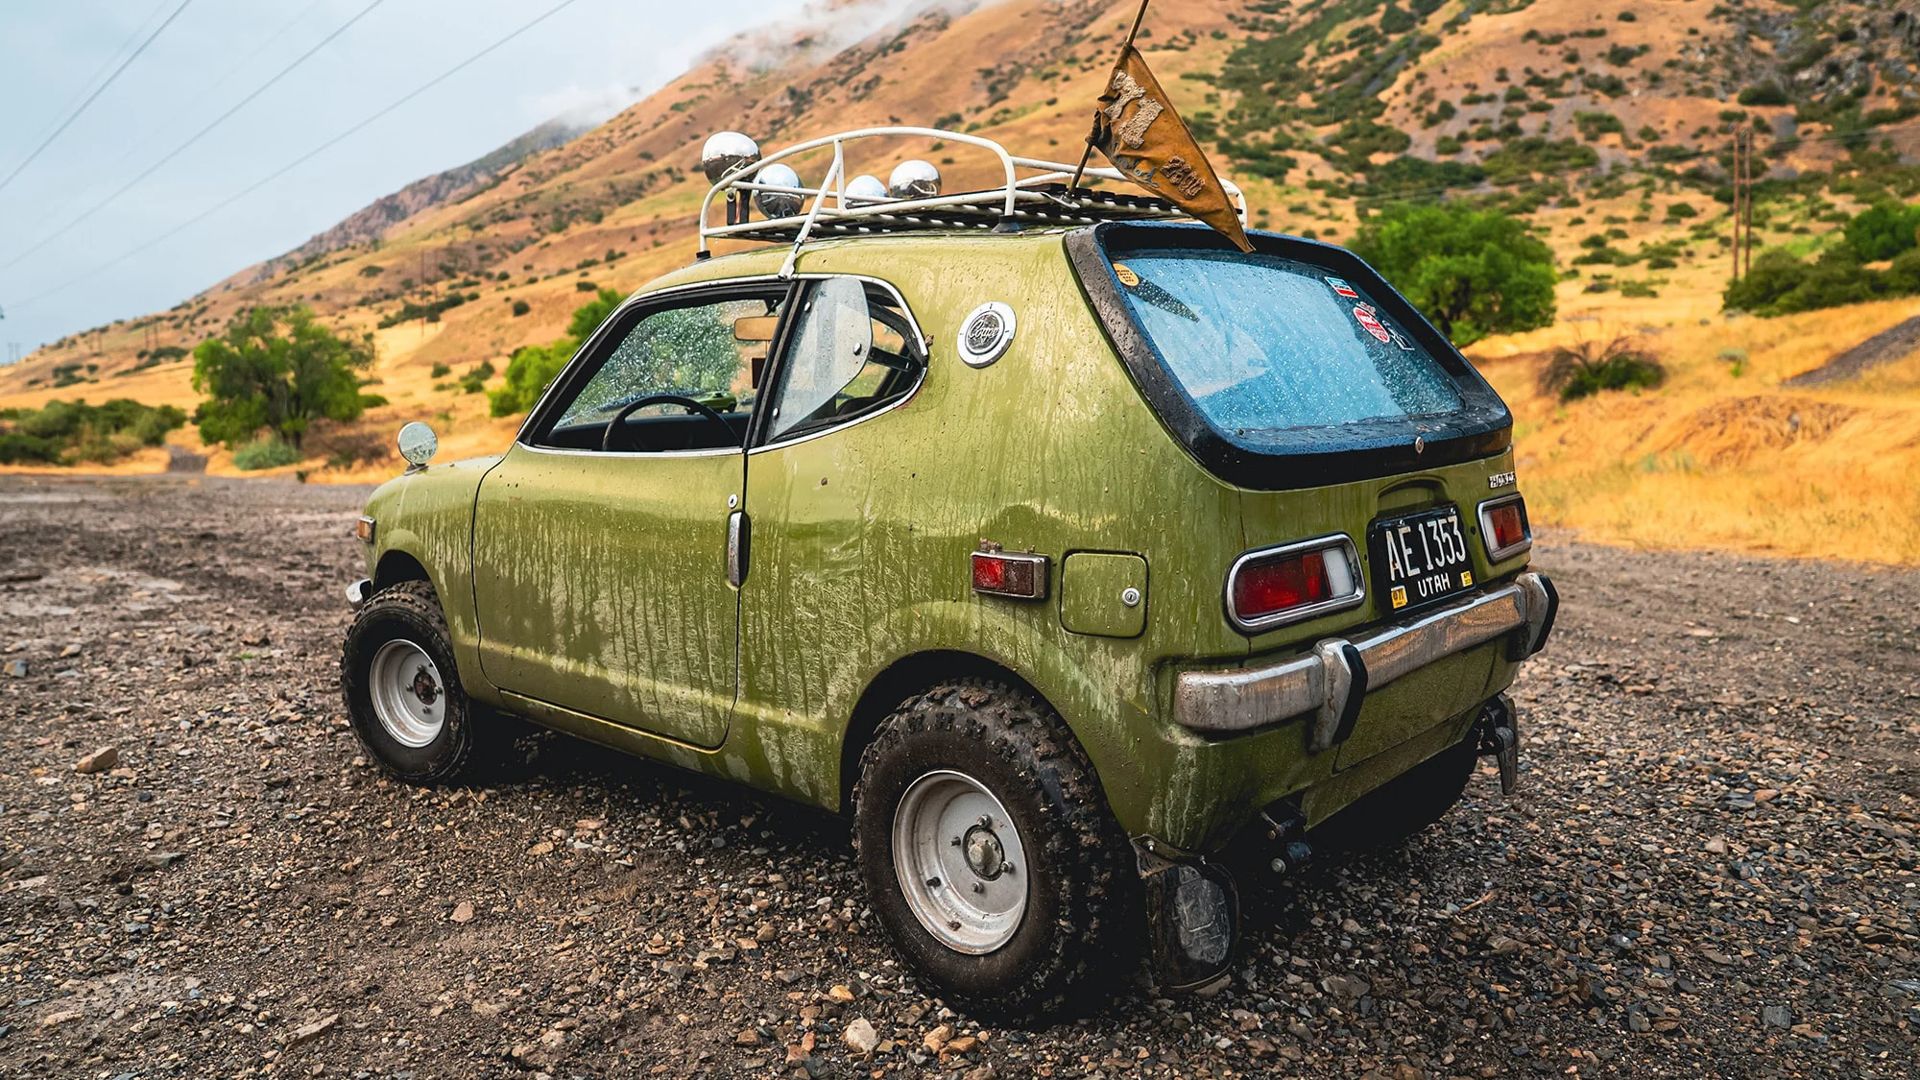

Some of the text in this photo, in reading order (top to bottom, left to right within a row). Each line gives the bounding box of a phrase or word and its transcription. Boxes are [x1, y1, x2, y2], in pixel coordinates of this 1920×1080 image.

[1385, 515, 1466, 581] AE 1353
[1417, 572, 1451, 597] UTAH
